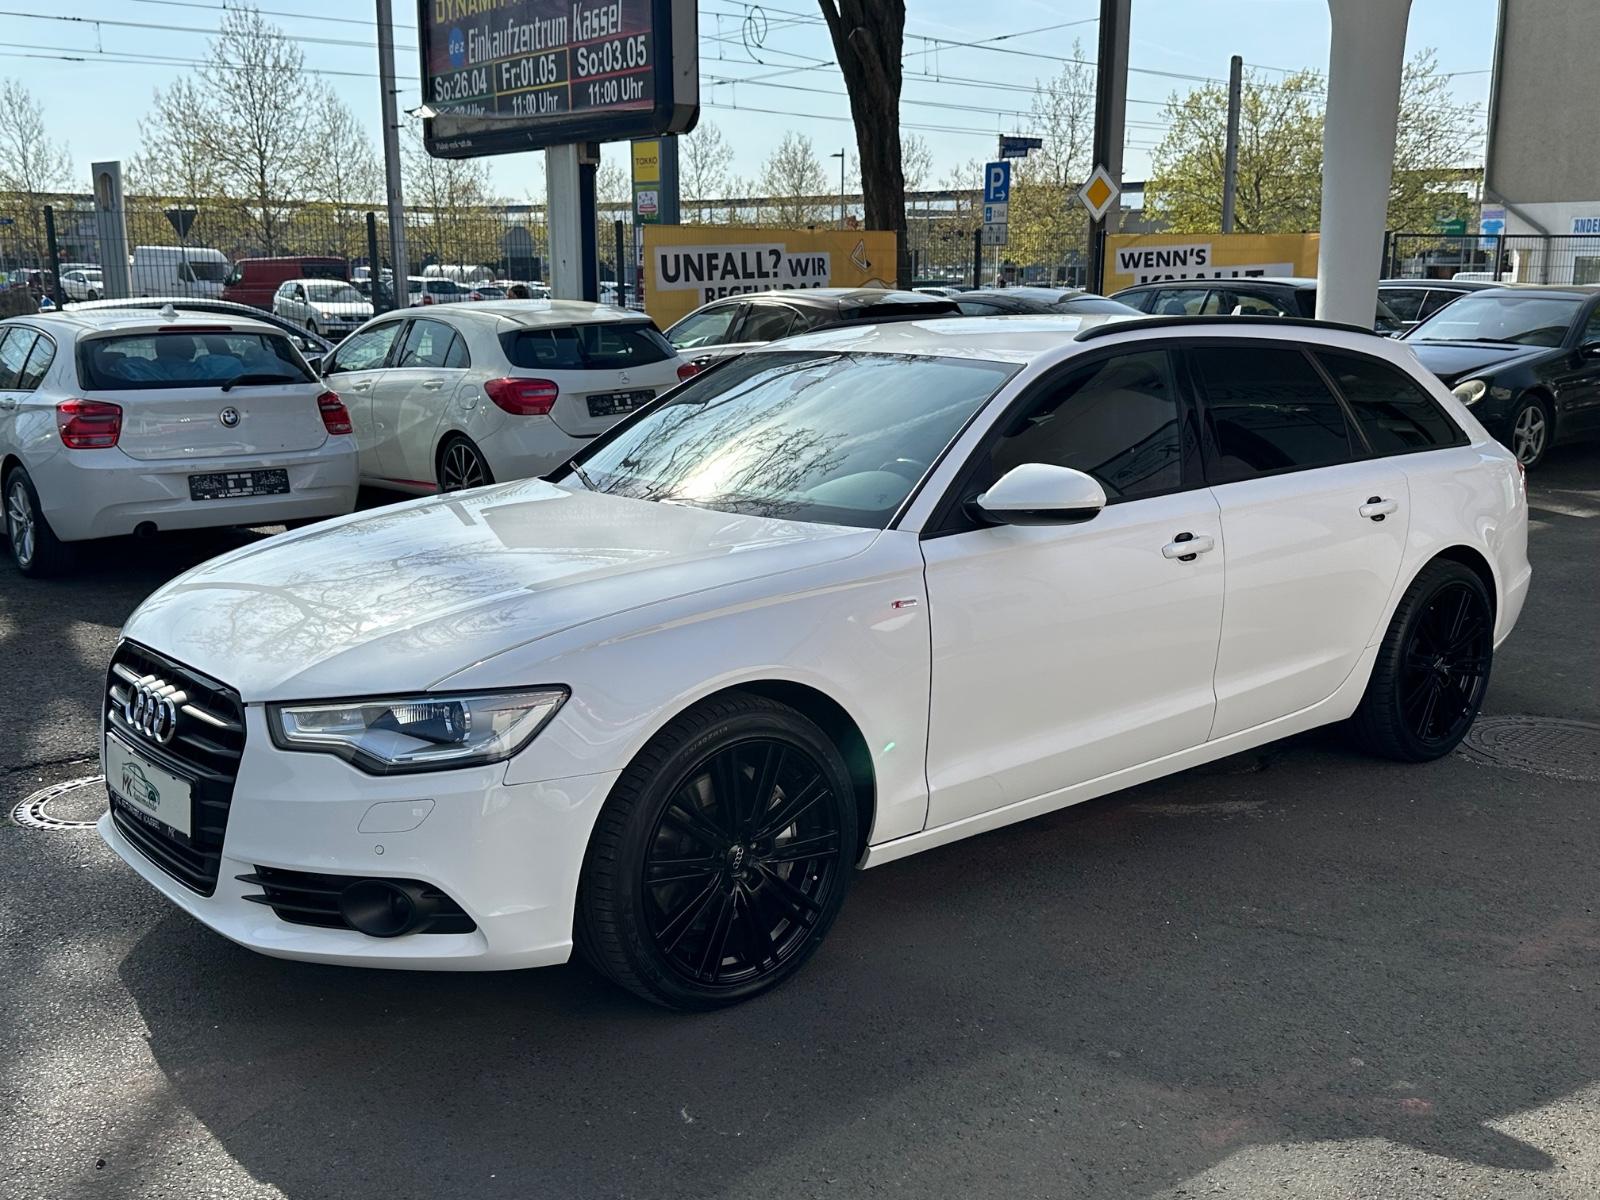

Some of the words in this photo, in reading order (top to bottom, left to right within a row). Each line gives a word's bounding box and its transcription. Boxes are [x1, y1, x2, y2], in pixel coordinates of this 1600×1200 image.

[468, 15, 567, 63] Einkaufzentrum
[572, 0, 623, 42] Kassel
[502, 54, 556, 90] Fr:01.05
[577, 35, 647, 77] So:03.05
[434, 69, 487, 101] So:26.04
[588, 82, 618, 105] 11:00
[621, 79, 643, 100] Uhr
[538, 93, 558, 113] Uhr
[990, 167, 1005, 200] P
[660, 249, 781, 283] UNFALL?
[787, 257, 827, 277] WIR
